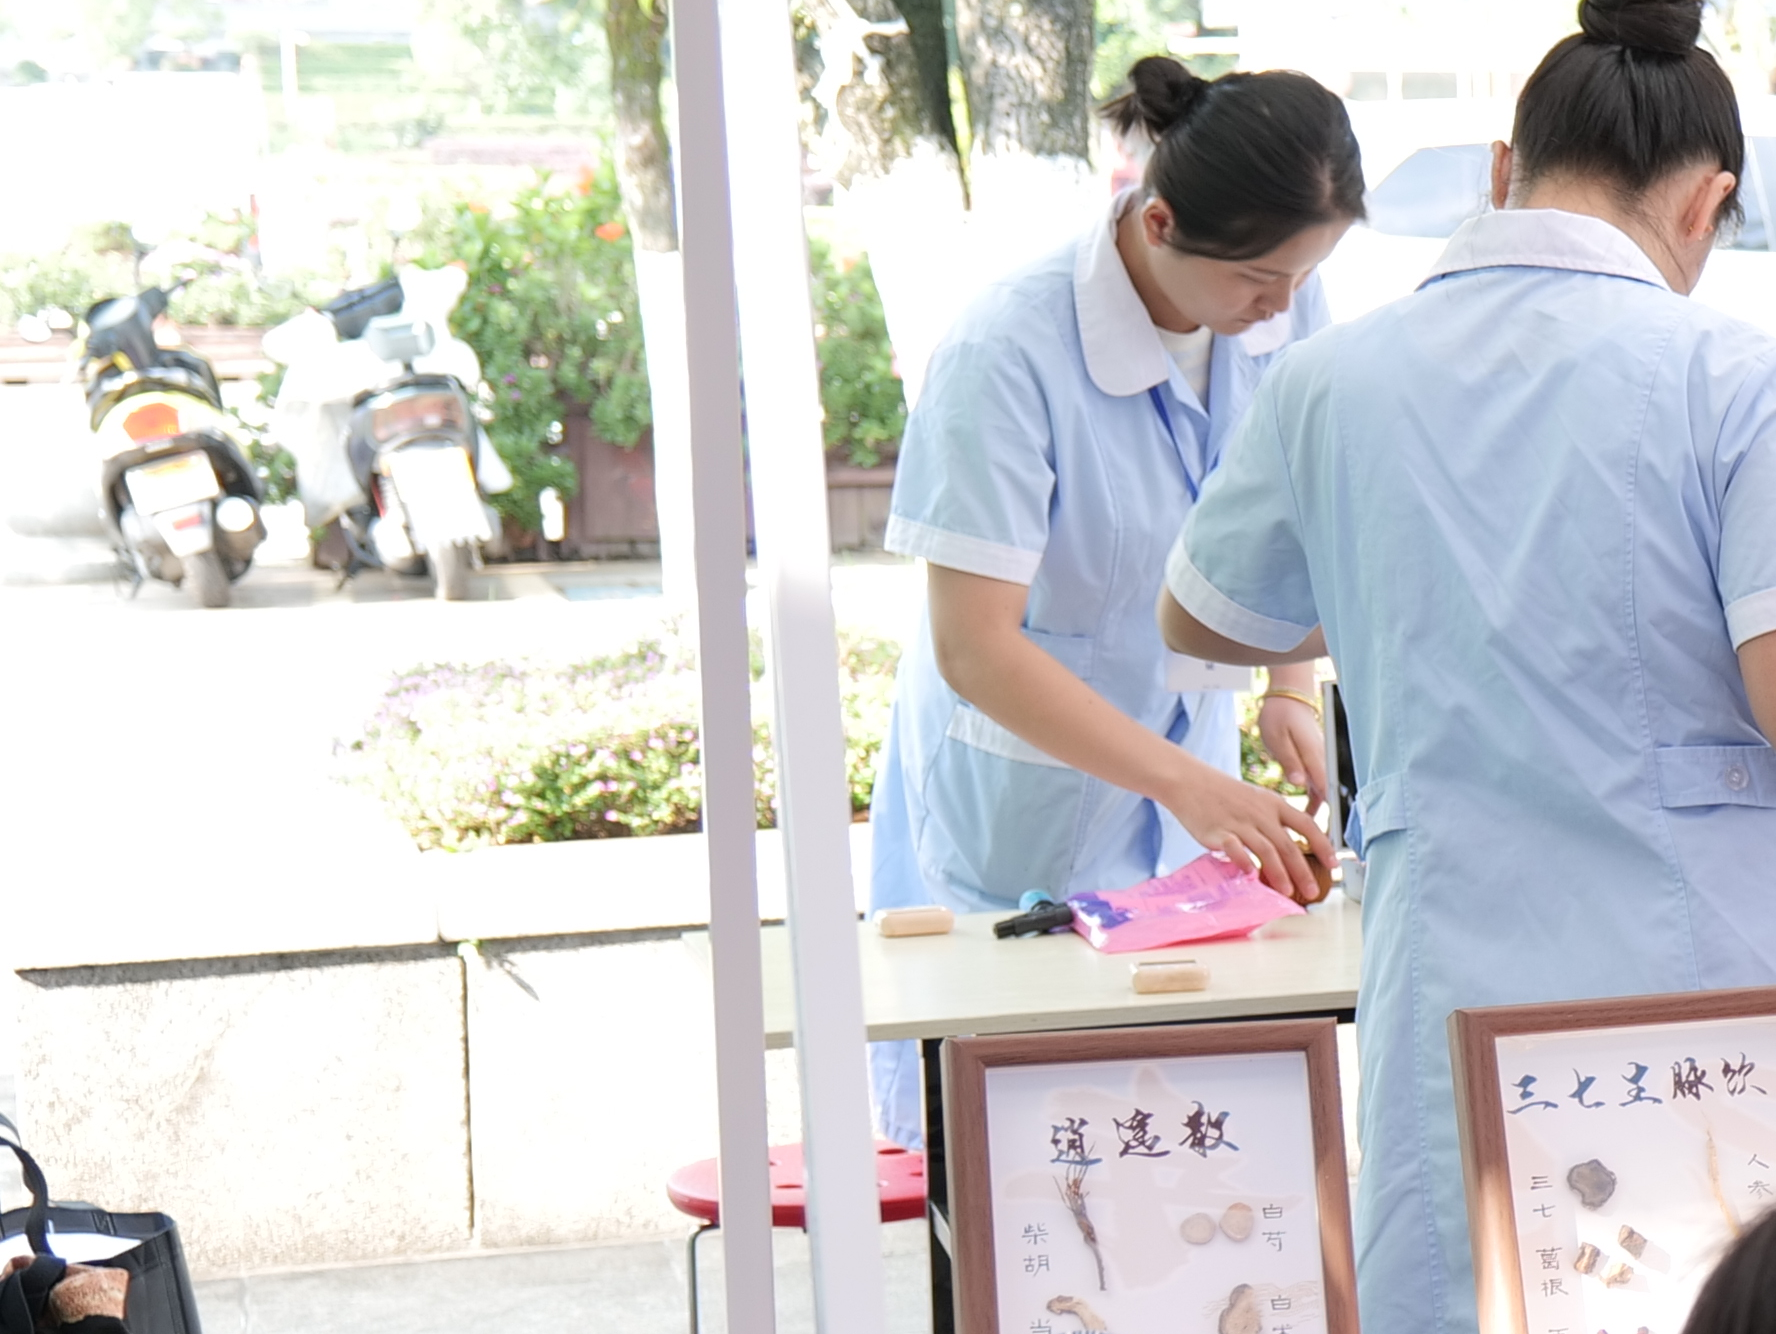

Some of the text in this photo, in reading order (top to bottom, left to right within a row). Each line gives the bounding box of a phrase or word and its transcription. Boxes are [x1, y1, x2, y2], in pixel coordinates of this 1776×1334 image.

[1530, 1175, 1556, 1218] 三七
[1747, 1153, 1774, 1199] 人参
[1021, 1222, 1050, 1277] 柴胡
[1262, 1203, 1287, 1252] 白芍
[1535, 1246, 1569, 1297] 葛根
